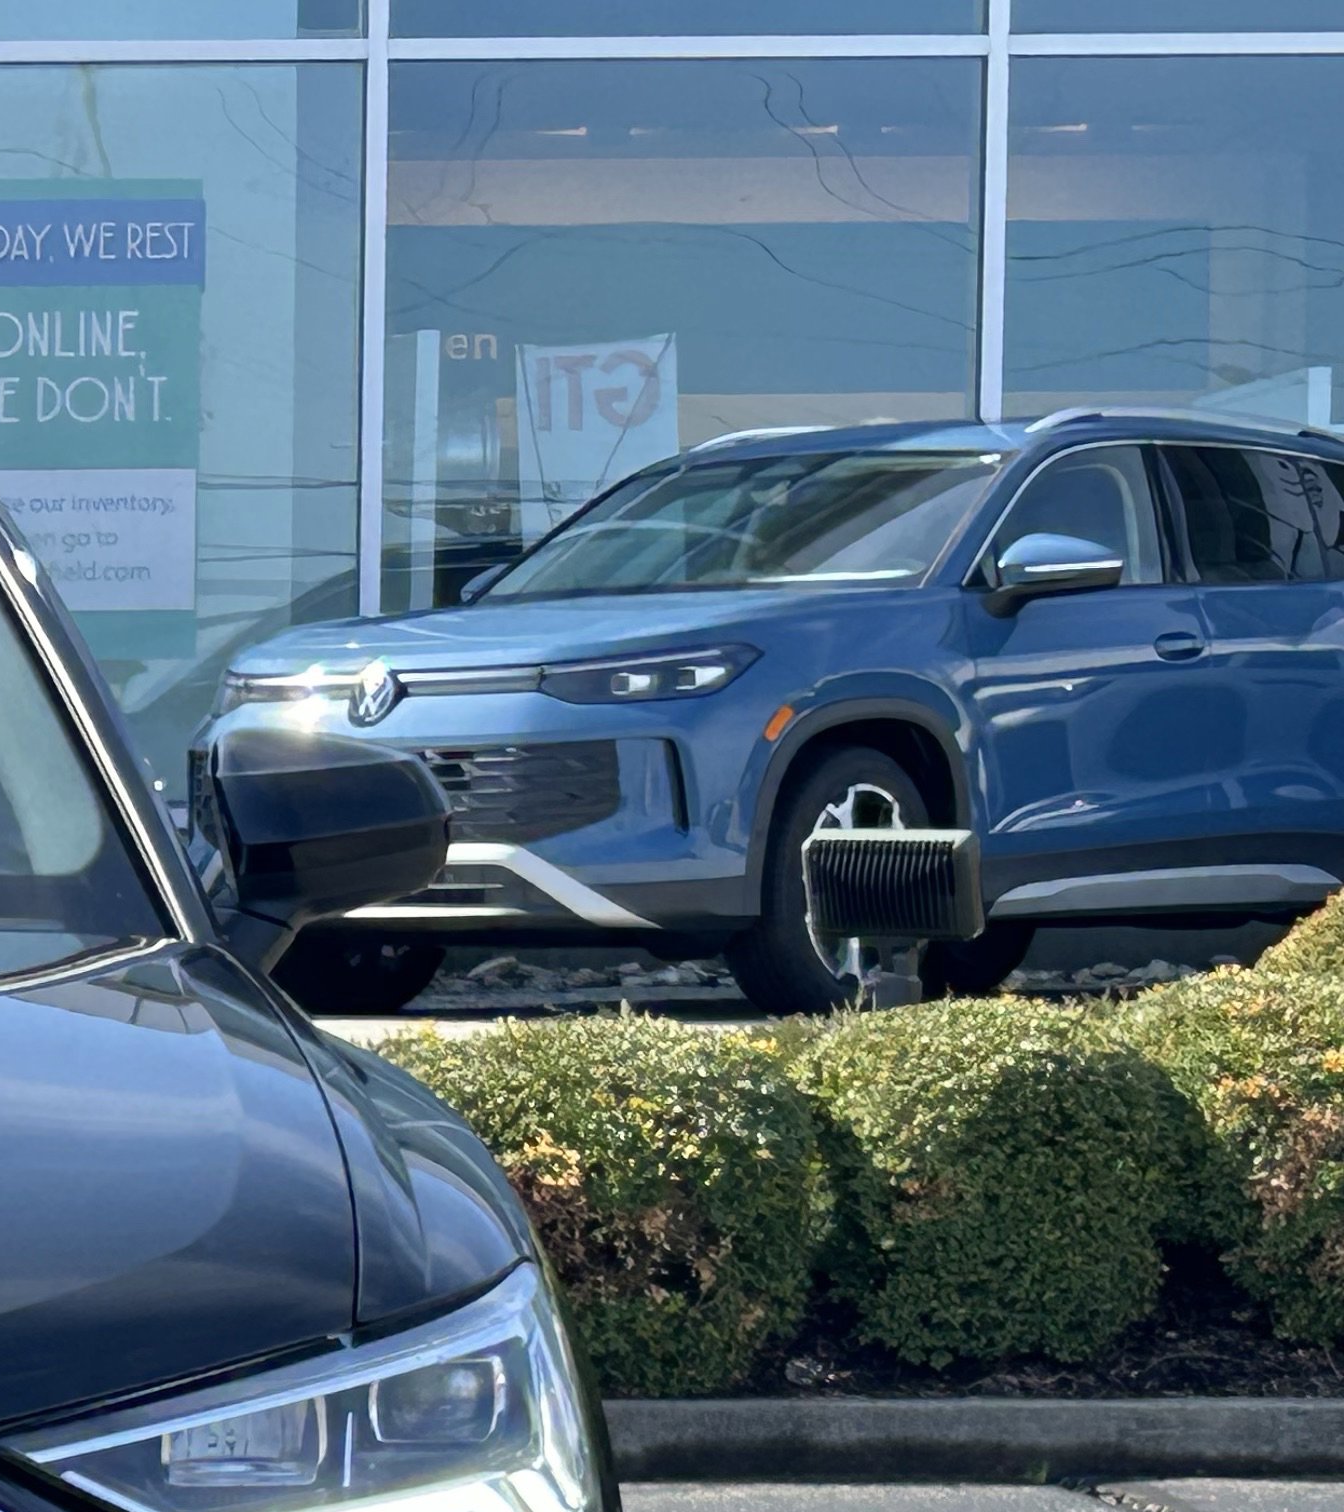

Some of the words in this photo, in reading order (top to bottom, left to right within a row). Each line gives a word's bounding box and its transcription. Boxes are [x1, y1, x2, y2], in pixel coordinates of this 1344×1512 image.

[63, 221, 116, 259] WE
[127, 221, 196, 260] REST
[28, 497, 65, 514] our
[62, 531, 91, 554] go
[96, 530, 119, 547] to
